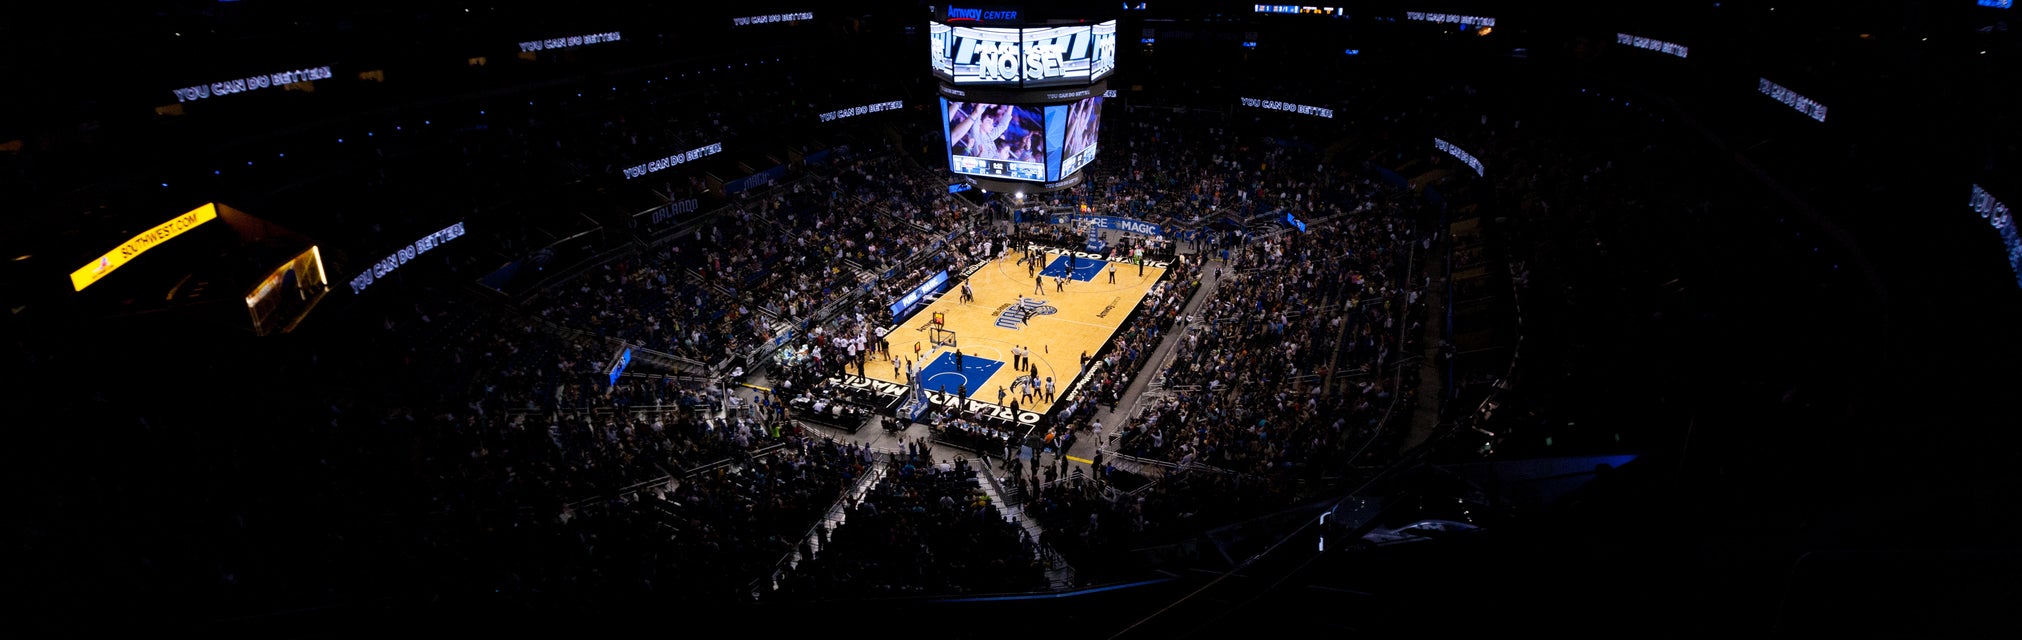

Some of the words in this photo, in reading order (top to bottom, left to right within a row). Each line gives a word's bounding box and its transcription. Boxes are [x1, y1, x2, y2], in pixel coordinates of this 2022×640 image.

[947, 4, 982, 21] Amway
[984, 11, 1017, 20] CENTER
[519, 40, 543, 52] YOU
[979, 51, 1065, 80] NOISE!
[173, 84, 210, 102] YOU
[211, 78, 247, 97] CAN
[246, 74, 270, 91] DO
[819, 110, 836, 122] YOU
[837, 107, 855, 118] CAN
[855, 105, 868, 115] DO
[1241, 96, 1261, 107] YOU
[1262, 100, 1282, 110] CAN
[1283, 102, 1297, 112] DO
[623, 163, 647, 179] YOU
[647, 157, 670, 172] CAN
[670, 153, 685, 166] DO
[121, 213, 198, 259] SOUTHWEST.COM
[1121, 220, 1157, 236] MAGIC
[350, 268, 373, 294] YOU
[373, 254, 399, 278] CAN
[398, 245, 416, 265] DO
